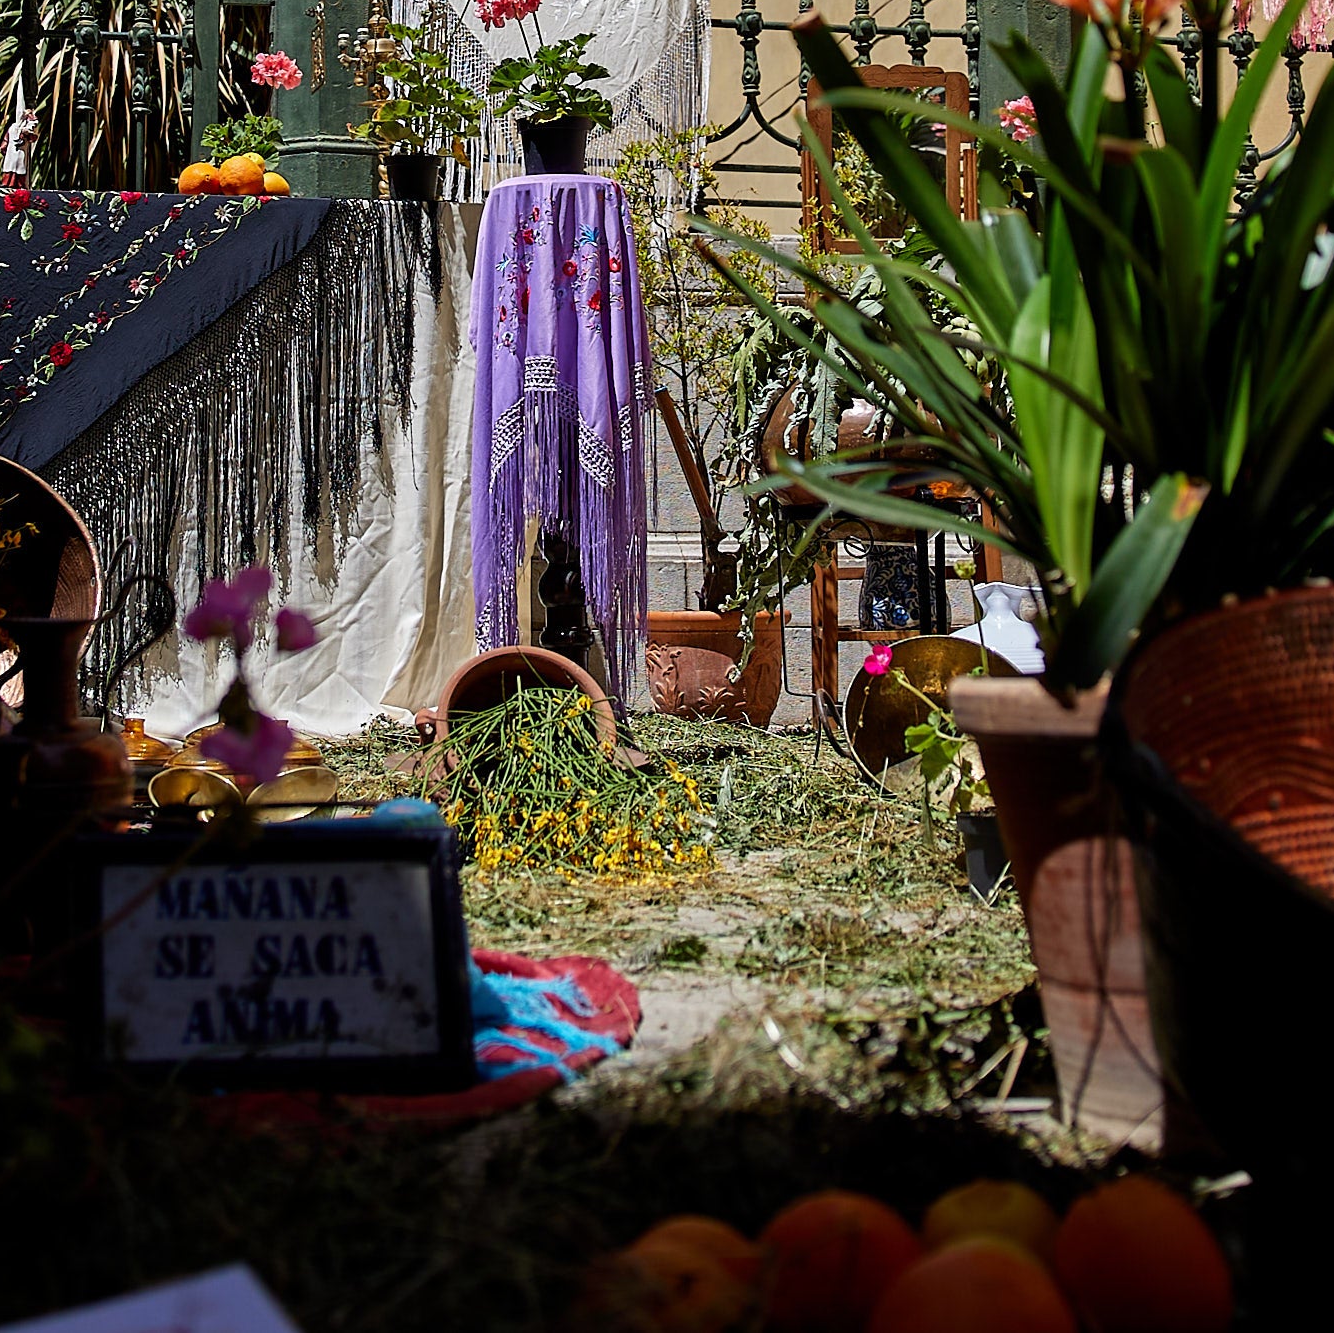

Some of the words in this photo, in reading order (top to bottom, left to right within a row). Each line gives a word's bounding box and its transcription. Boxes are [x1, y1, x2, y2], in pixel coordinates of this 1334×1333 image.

[156, 865, 351, 920] MAÑANA
[155, 933, 216, 979] SE
[250, 931, 385, 979] SACA
